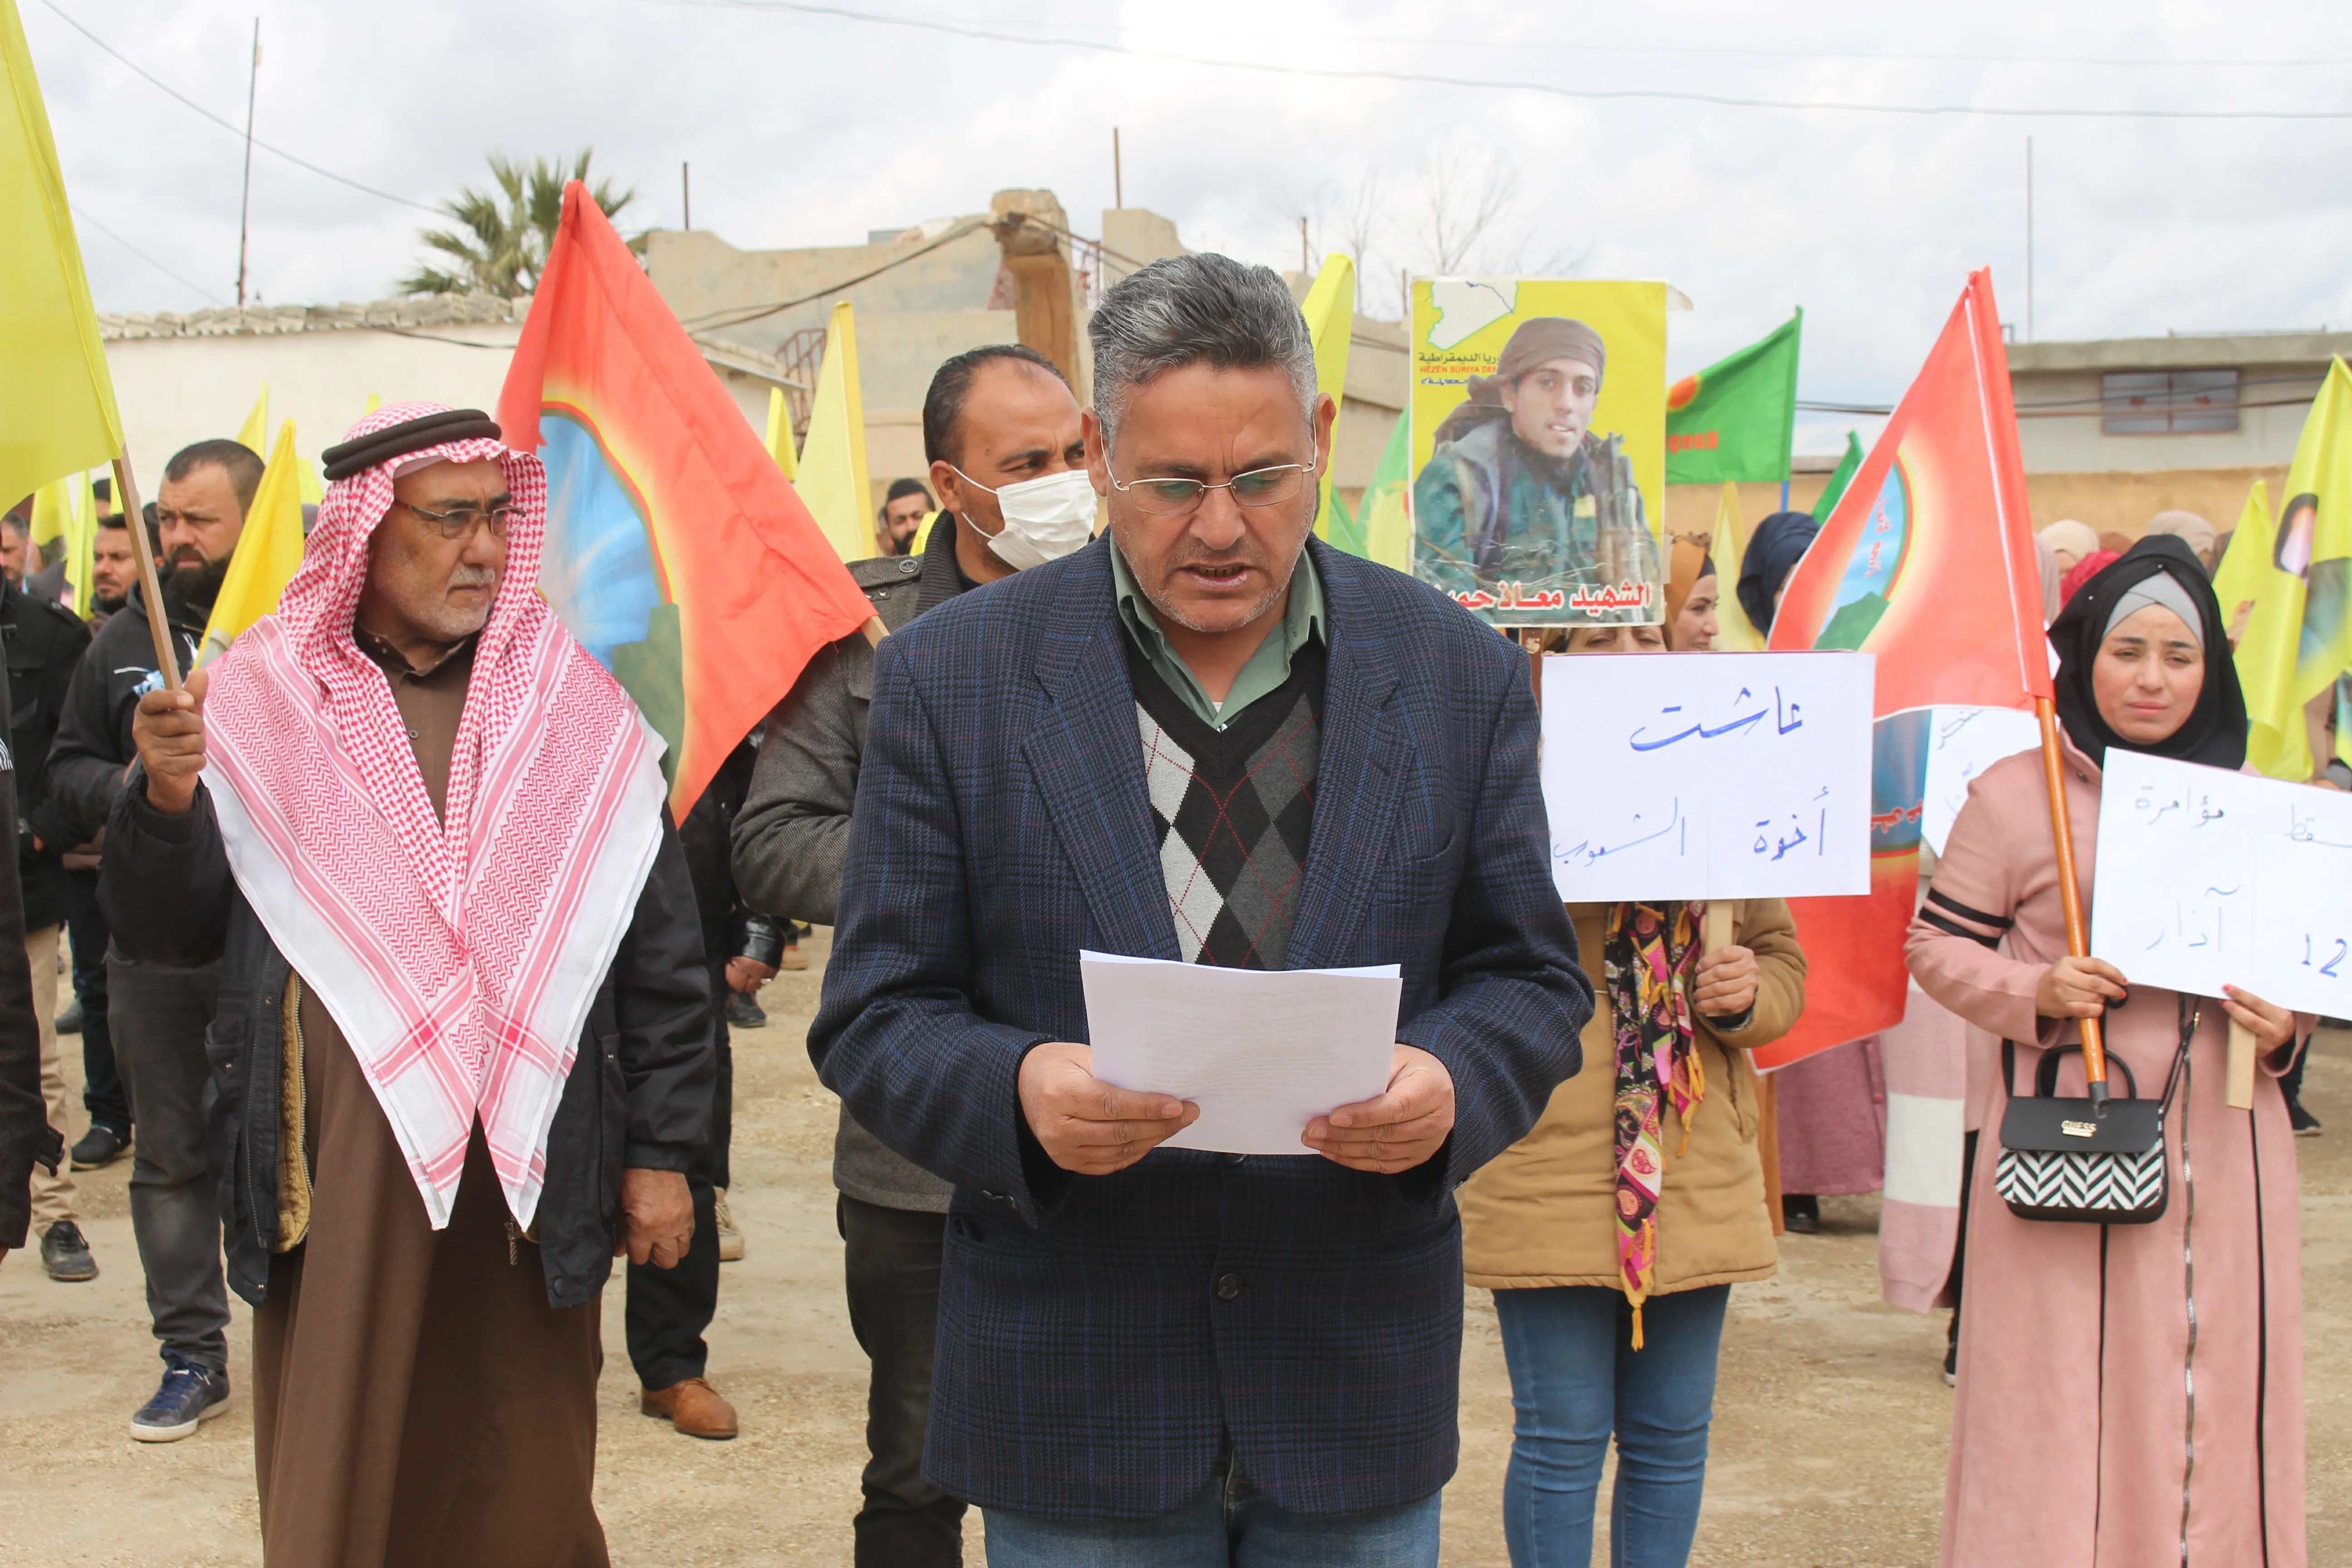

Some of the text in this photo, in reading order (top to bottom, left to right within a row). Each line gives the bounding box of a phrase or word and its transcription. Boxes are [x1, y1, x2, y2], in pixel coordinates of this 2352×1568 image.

[1419, 352, 1481, 364] الديمقراطية
[1420, 364, 1447, 373] HÊZÊN
[1572, 581, 1650, 613] الشهيد
[1630, 686, 1803, 751] عاشت
[2135, 785, 2224, 828] مؤامرة
[2145, 884, 2241, 953] آذار
[2301, 933, 2347, 978] 12
[2061, 1120, 2097, 1132] GUESS
